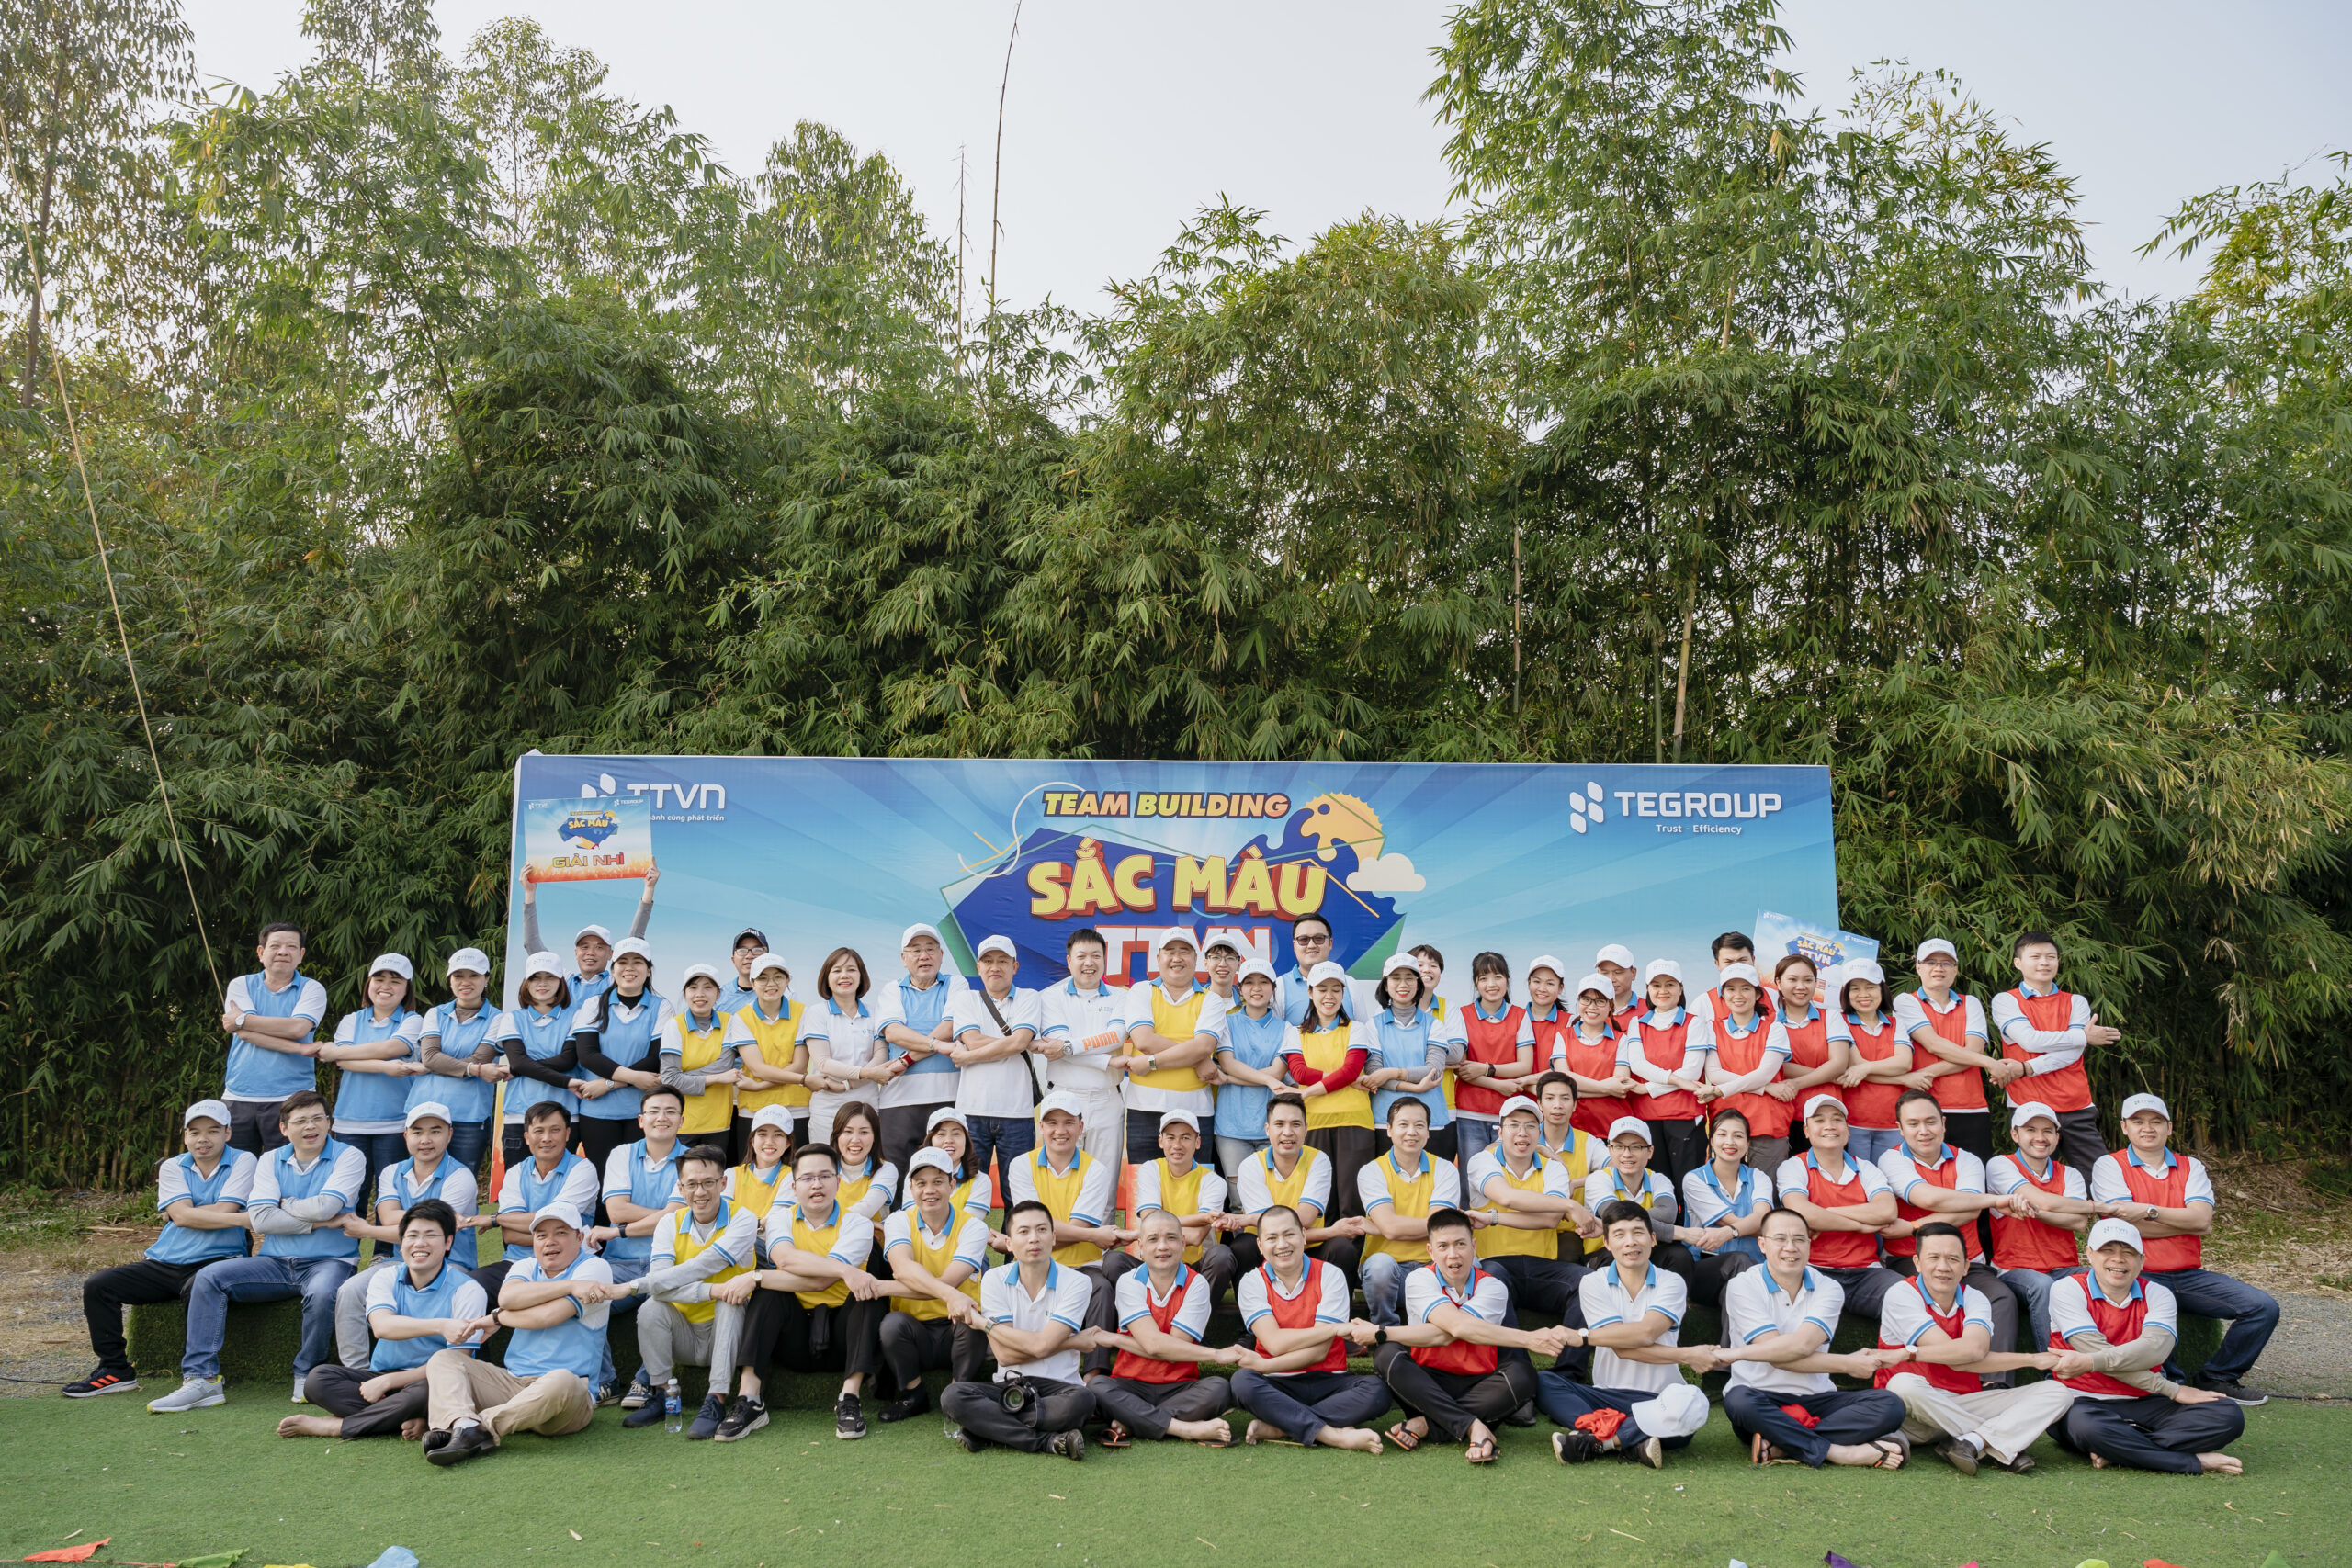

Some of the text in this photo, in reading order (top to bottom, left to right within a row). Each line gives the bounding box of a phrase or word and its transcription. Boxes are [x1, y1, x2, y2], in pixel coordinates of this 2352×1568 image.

[1043, 791, 1291, 818] TEAM BUILDING
[1614, 792, 1781, 818] TEGROUP
[667, 815, 685, 823] cùng
[687, 814, 704, 823] phát
[1656, 824, 1682, 833] Trust
[1692, 824, 1742, 835] Efficiency
[552, 852, 588, 868] GIẢI
[1027, 836, 1328, 920] SẮC MÀU
[1082, 1031, 1120, 1051] PUMA
